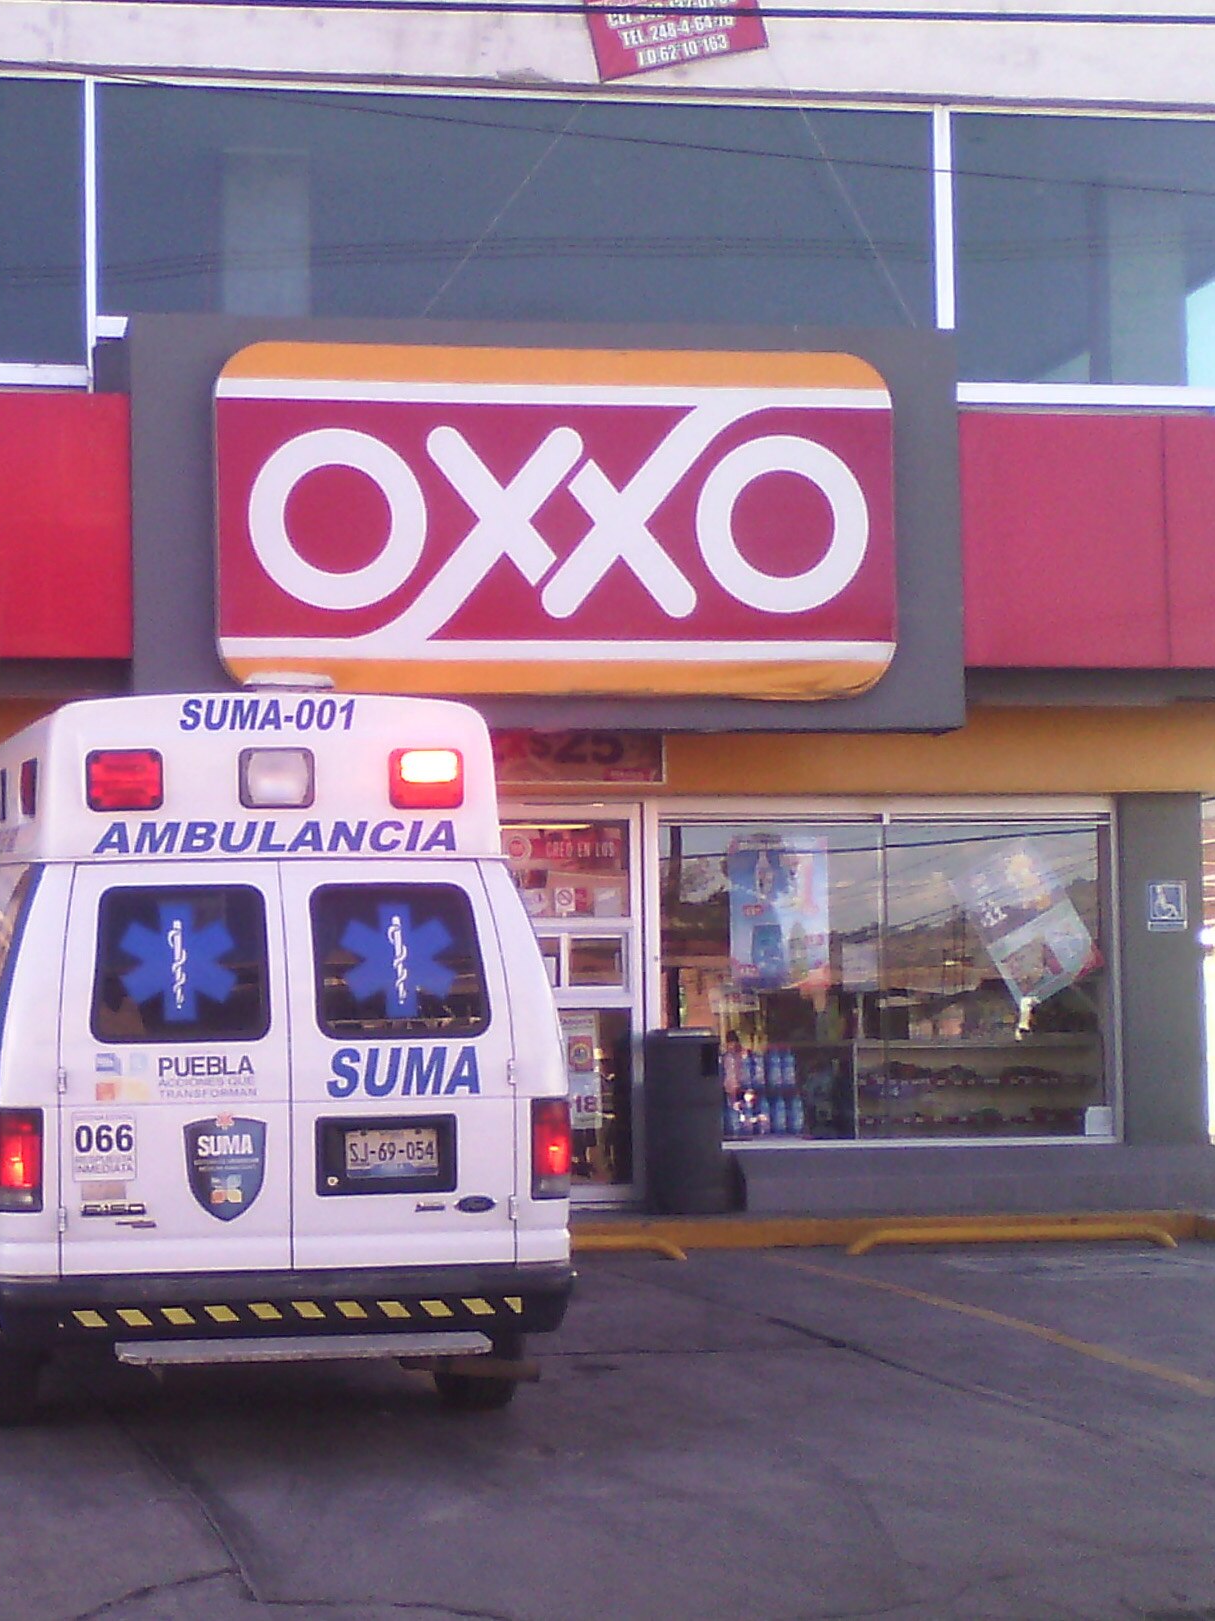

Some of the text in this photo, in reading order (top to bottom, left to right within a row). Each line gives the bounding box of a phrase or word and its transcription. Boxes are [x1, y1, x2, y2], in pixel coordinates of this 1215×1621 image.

[247, 424, 870, 618] OXXO
[179, 699, 355, 731] SUMA-001
[93, 820, 458, 854] AMBULANCIA
[158, 1055, 255, 1077] PUEBLA
[326, 1046, 481, 1098] SUMA
[160, 1088, 257, 1099] TRANSFORMAN
[74, 1124, 134, 1153] 066
[197, 1133, 254, 1157] SUMA
[349, 1141, 435, 1163] SJ-69-054
